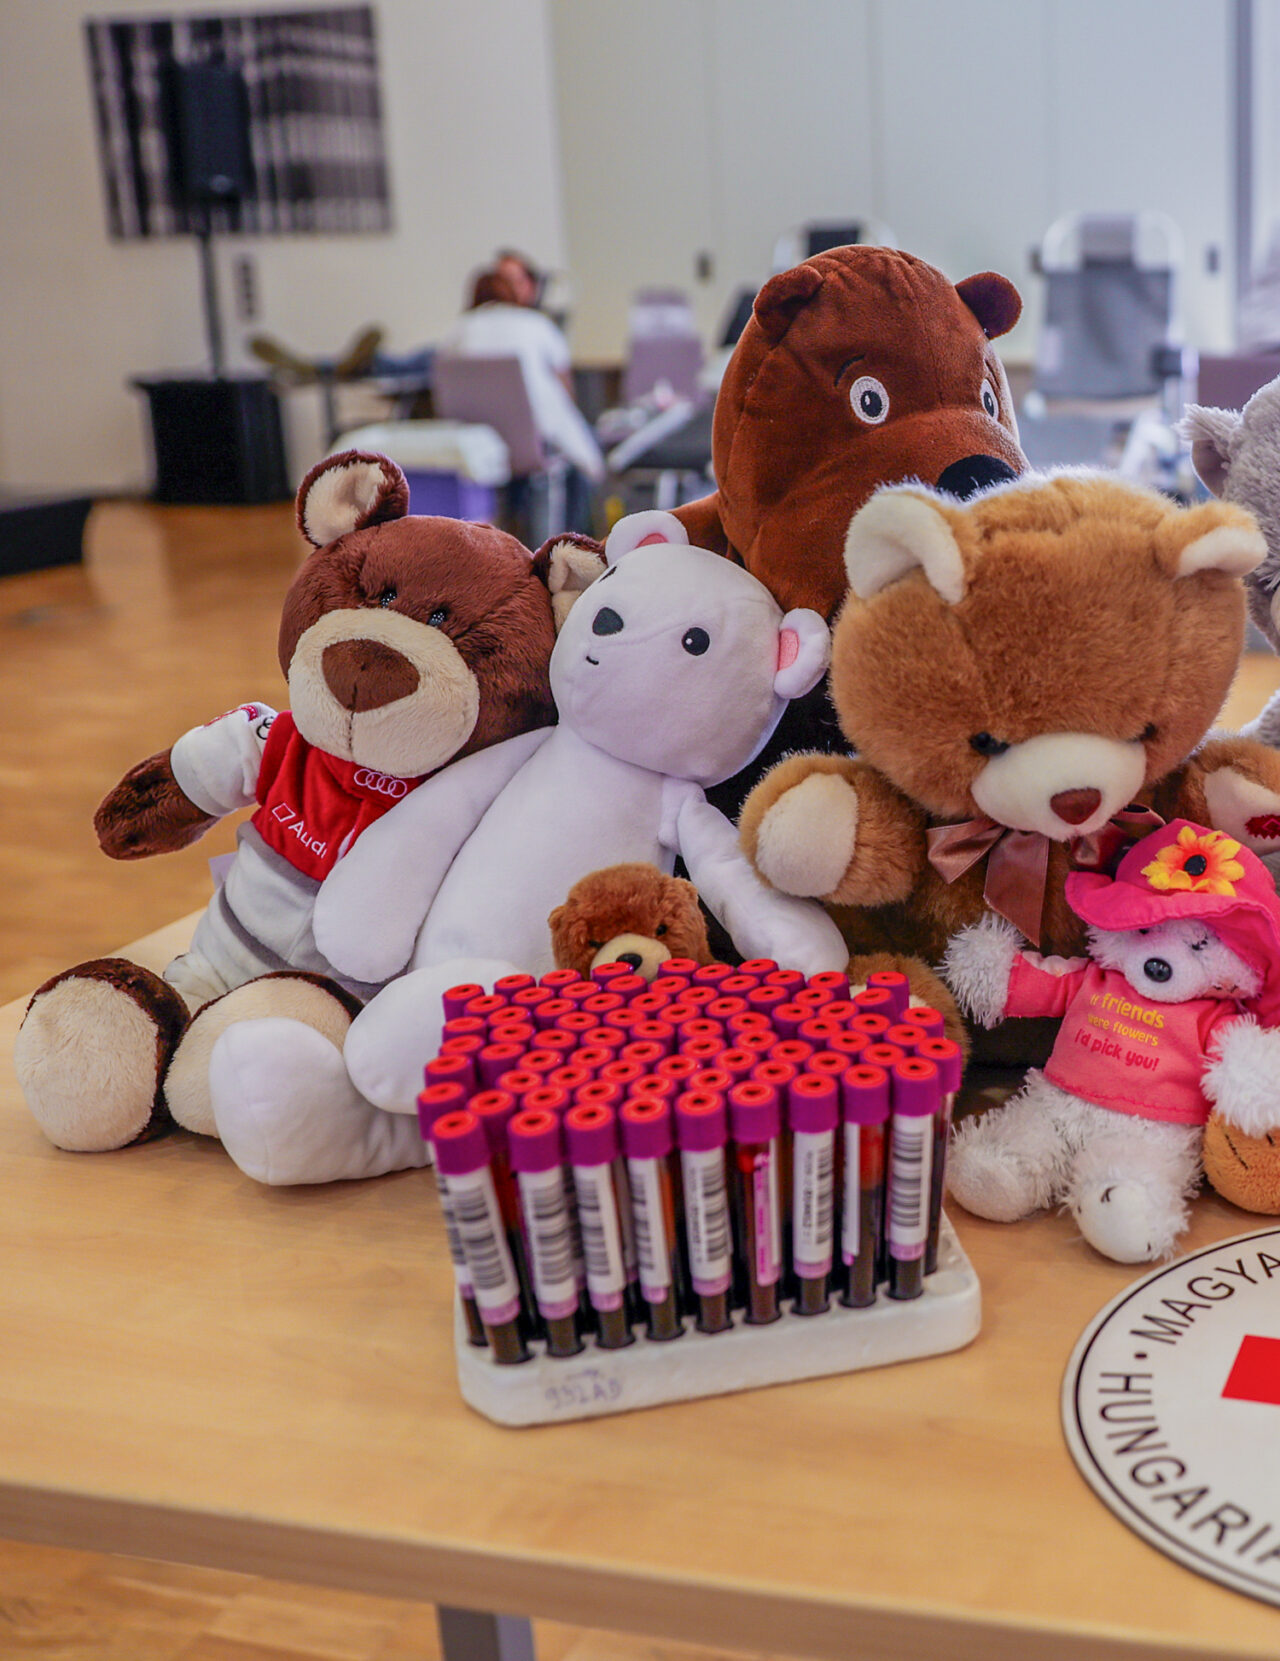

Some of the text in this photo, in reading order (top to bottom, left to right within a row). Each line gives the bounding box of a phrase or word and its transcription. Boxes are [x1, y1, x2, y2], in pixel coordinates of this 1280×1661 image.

[288, 820, 327, 859] Audi
[1101, 993, 1165, 1029] friends
[1088, 1014, 1159, 1047] were flowers
[1074, 1028, 1160, 1071] I'd pick you!
